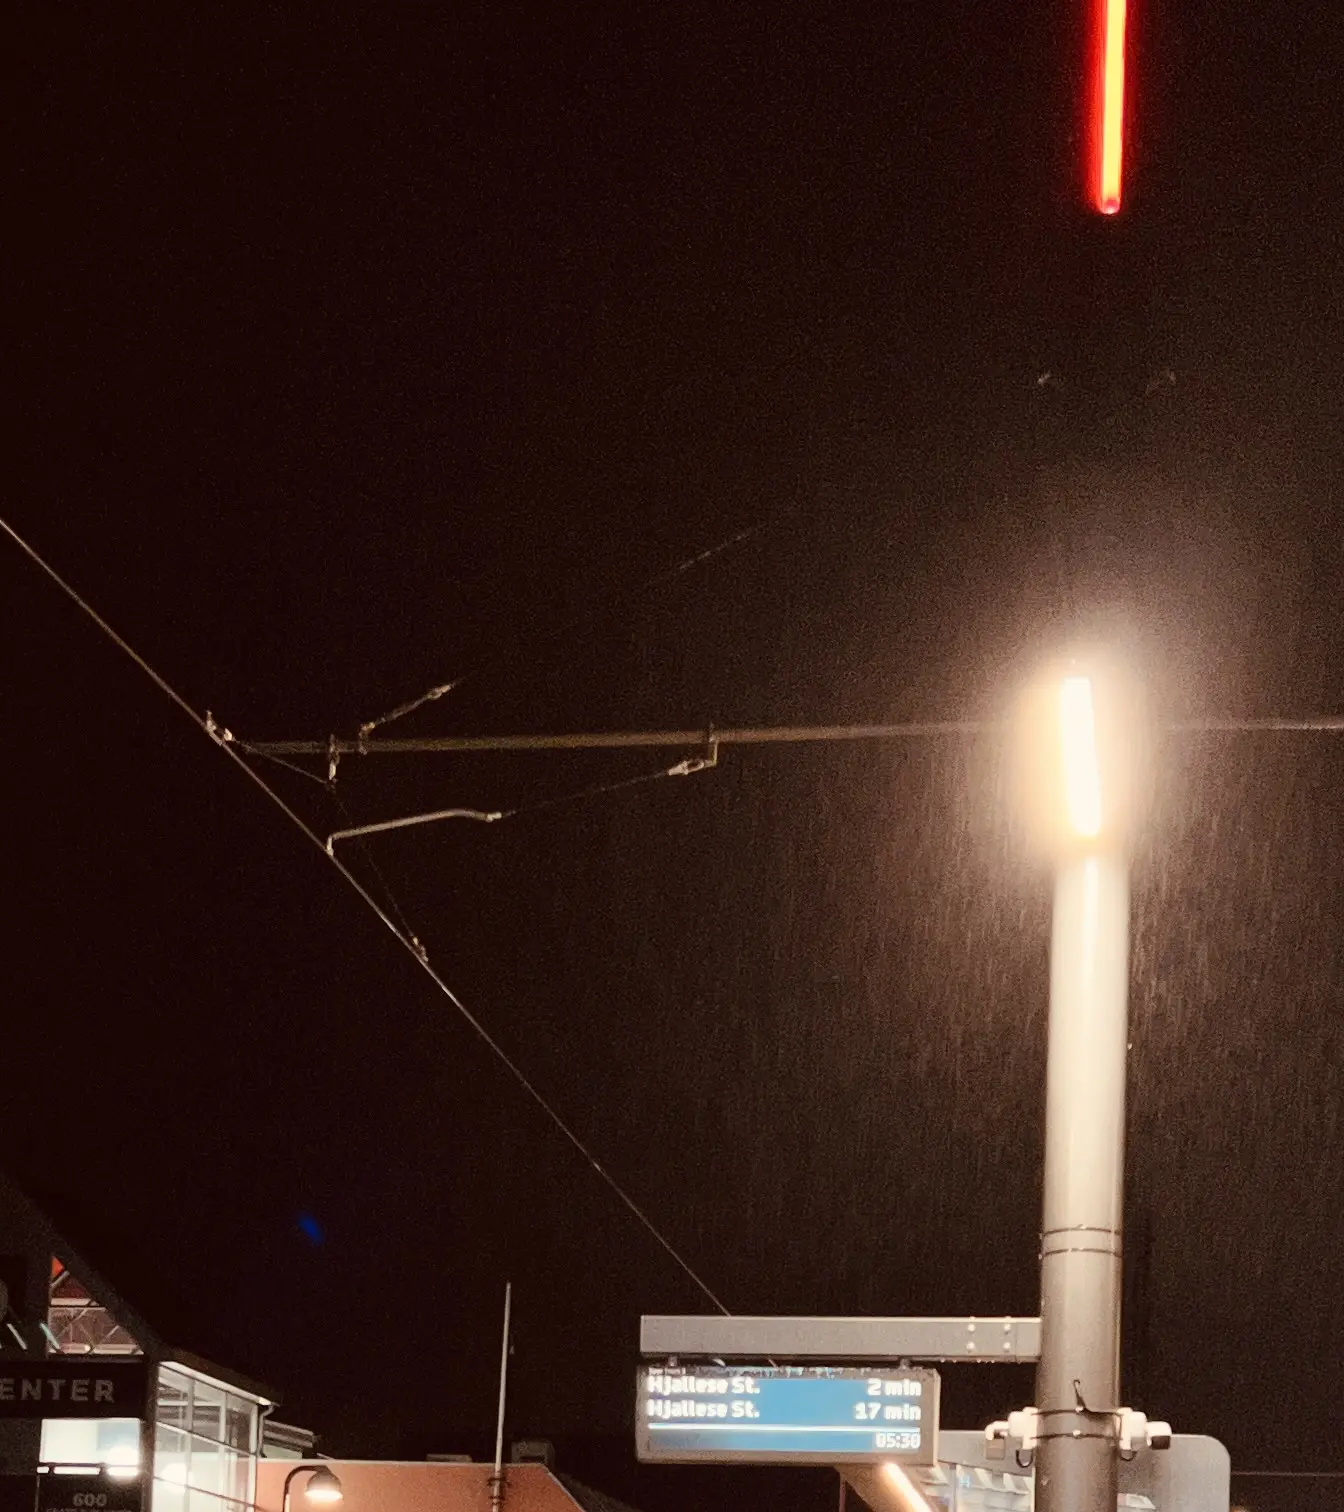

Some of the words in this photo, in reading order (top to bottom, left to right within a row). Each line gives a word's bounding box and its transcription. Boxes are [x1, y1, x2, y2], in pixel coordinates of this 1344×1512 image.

[647, 1375, 728, 1396] Hjallese
[731, 1376, 761, 1394] St.
[867, 1378, 882, 1396] 2
[885, 1378, 922, 1396] min
[647, 1399, 728, 1419] Hjallese
[731, 1400, 761, 1418] St.
[853, 1402, 882, 1420] 17
[884, 1403, 922, 1420] min
[875, 1432, 921, 1449] 05:30
[72, 1493, 108, 1507] 600
